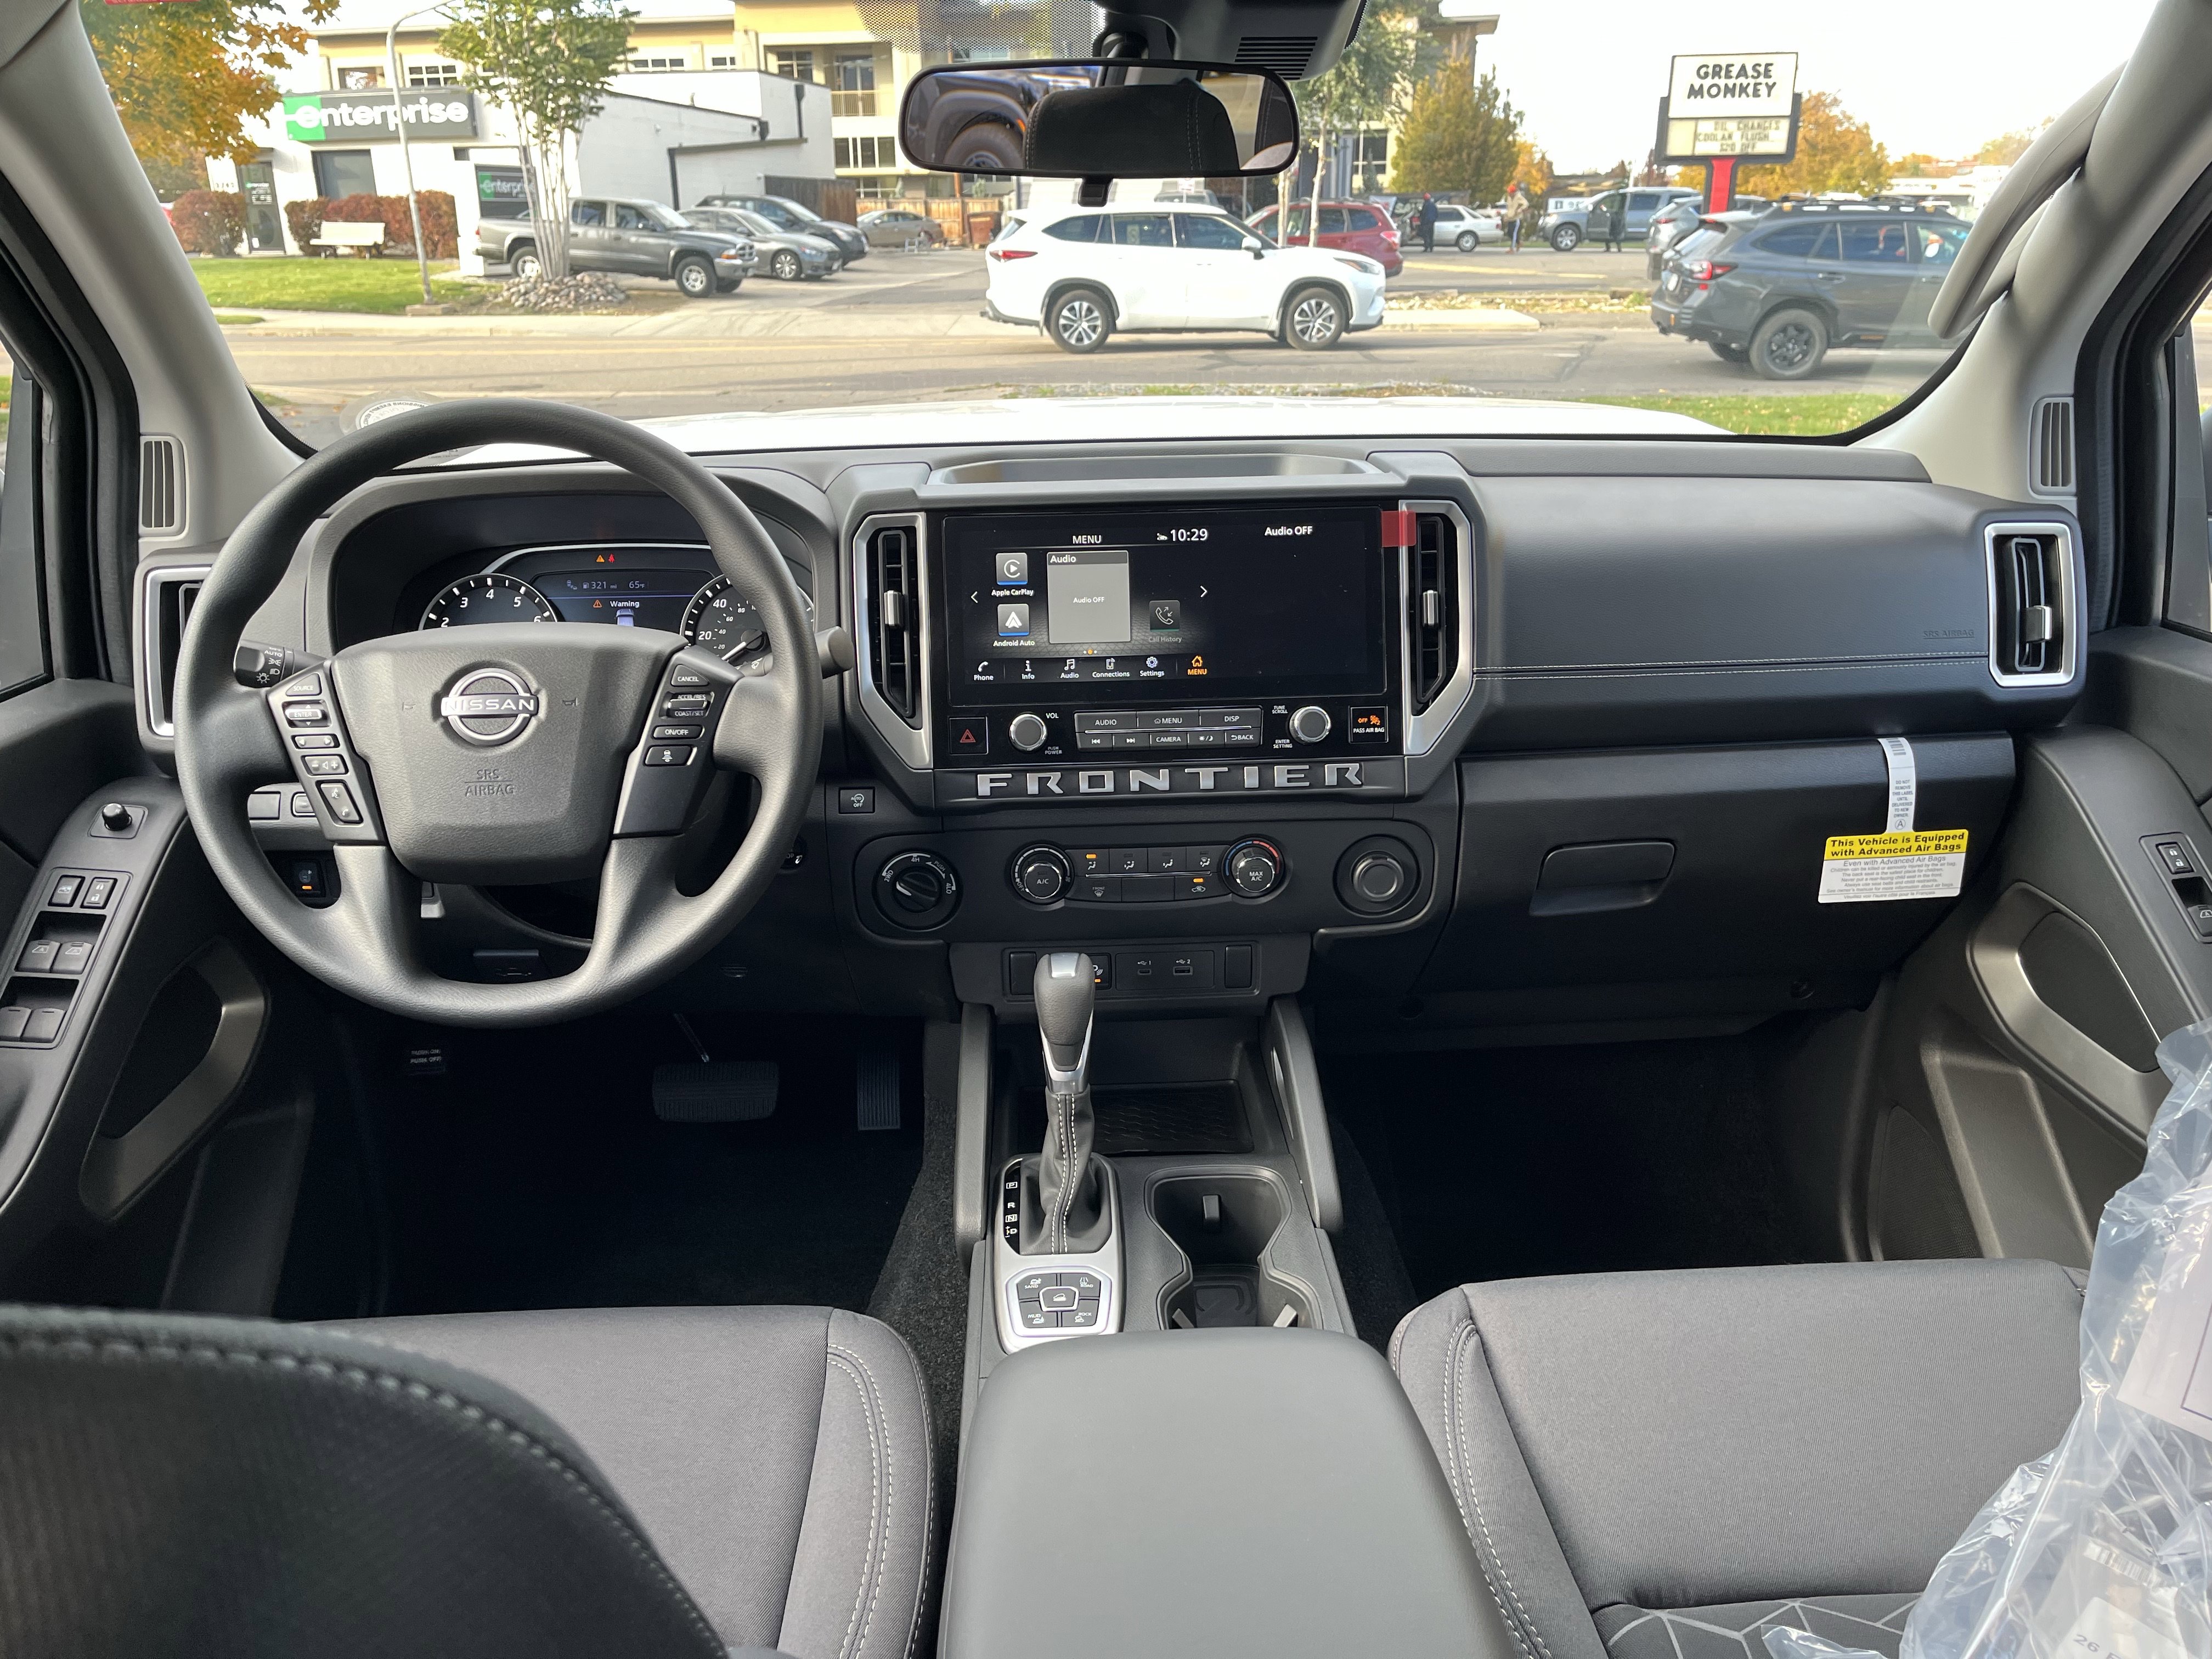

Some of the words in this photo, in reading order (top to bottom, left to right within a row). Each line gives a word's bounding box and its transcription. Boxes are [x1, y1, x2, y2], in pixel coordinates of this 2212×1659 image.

[1696, 63, 1774, 80] GREASE
[1687, 82, 1777, 99] MONKEY
[295, 97, 469, 131] enterprise
[1737, 120, 1780, 131] CHANGES
[1170, 528, 1208, 542] 10:29
[1265, 526, 1293, 536] Audio
[1294, 525, 1313, 535] OFF
[1072, 535, 1102, 544] MENU
[1050, 555, 1077, 563] Audio
[591, 581, 607, 589] 321
[486, 589, 494, 599] 4
[460, 597, 469, 608] 3
[513, 596, 522, 607] 5
[610, 600, 640, 608] Warning
[713, 599, 727, 608] 40
[441, 617, 449, 628] 2
[698, 631, 712, 640] 20
[1139, 669, 1165, 678] Settings
[445, 698, 534, 712] NISSAN
[477, 769, 500, 780] SRS
[977, 762, 1362, 796] FRONTIER
[465, 783, 515, 797] AIRBAG
[1859, 837, 1898, 845] Vehicle
[1915, 832, 1965, 843] Equipped
[1831, 848, 1854, 856] with
[1859, 845, 1912, 855] Advanced
[1934, 843, 1961, 853] Bags
[1880, 857, 1915, 865] Advanced
[884, 870, 894, 883] 2WD
[2072, 1634, 2101, 1653] 26
